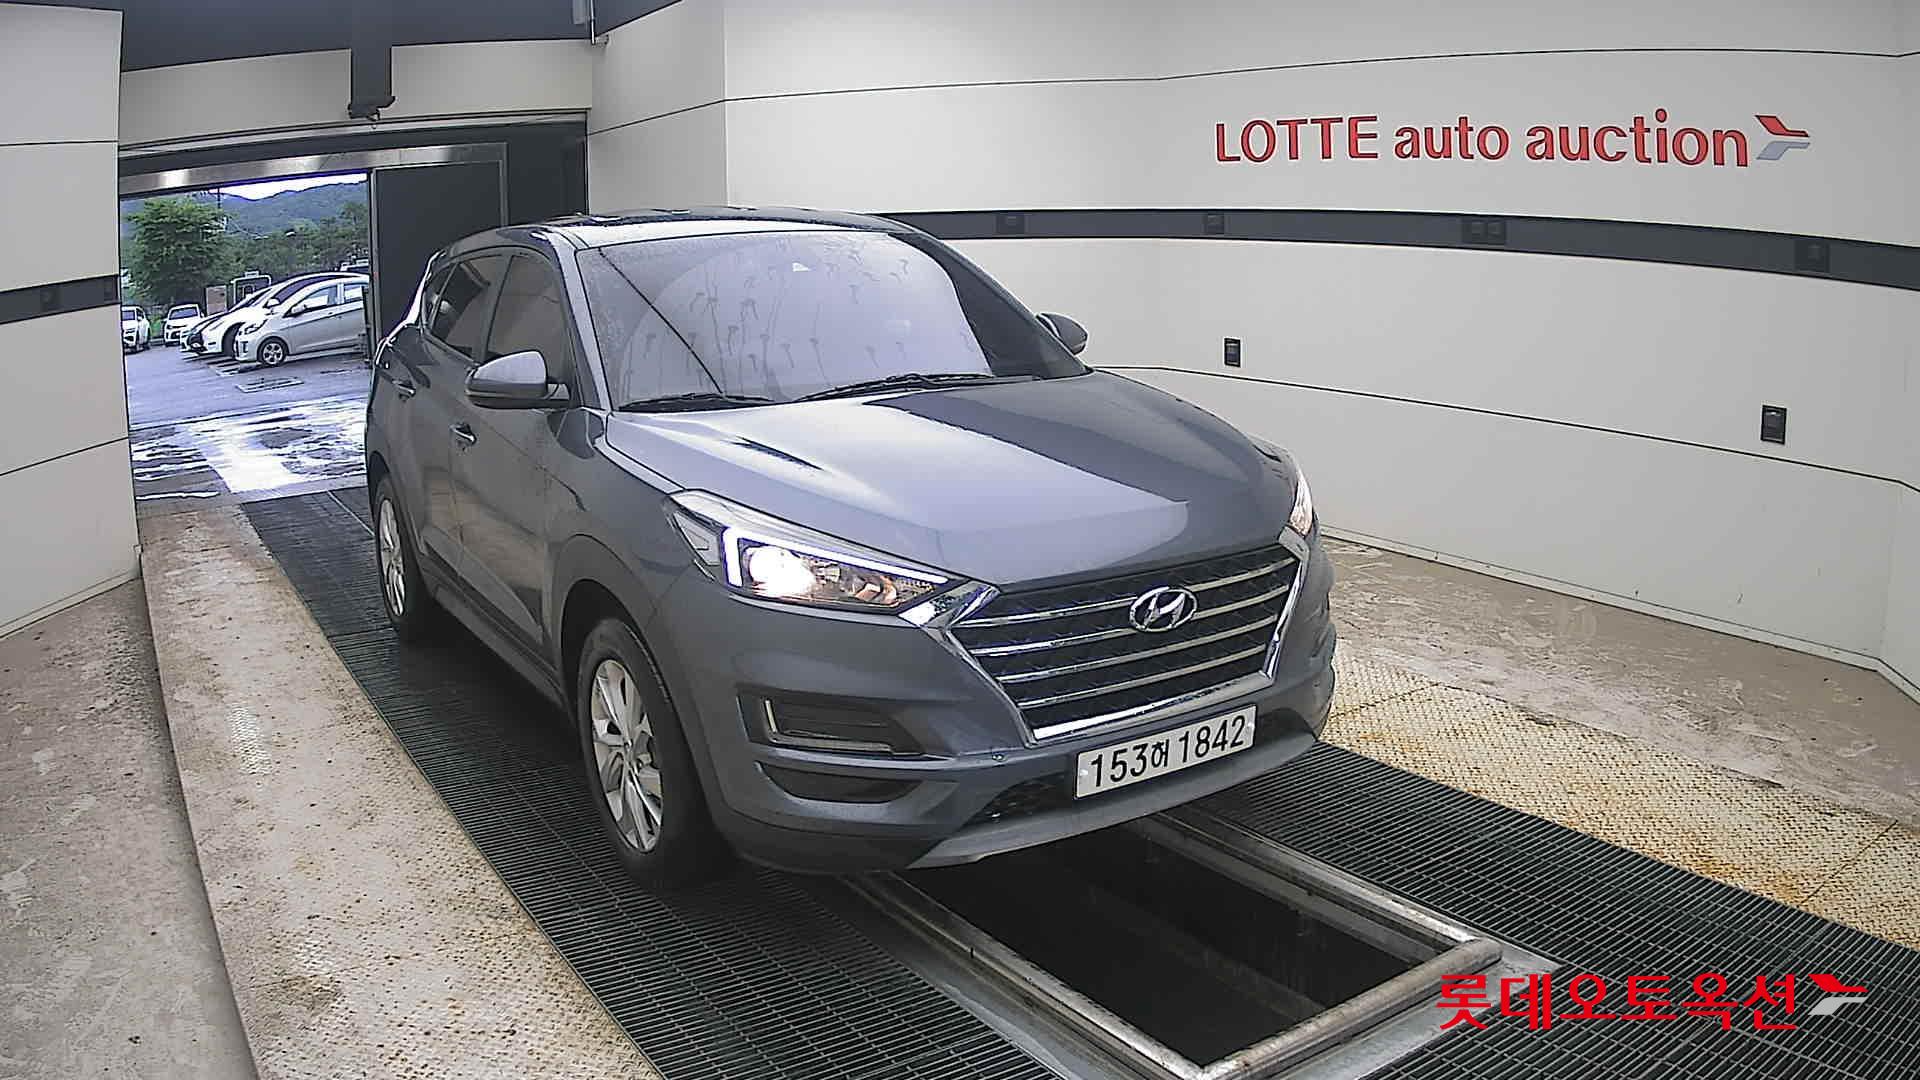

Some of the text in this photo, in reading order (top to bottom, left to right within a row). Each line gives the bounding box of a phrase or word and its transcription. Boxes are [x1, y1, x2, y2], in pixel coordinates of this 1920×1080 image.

[1215, 108, 1748, 168] LOTTE auto auction
[1178, 714, 1246, 764] 1842
